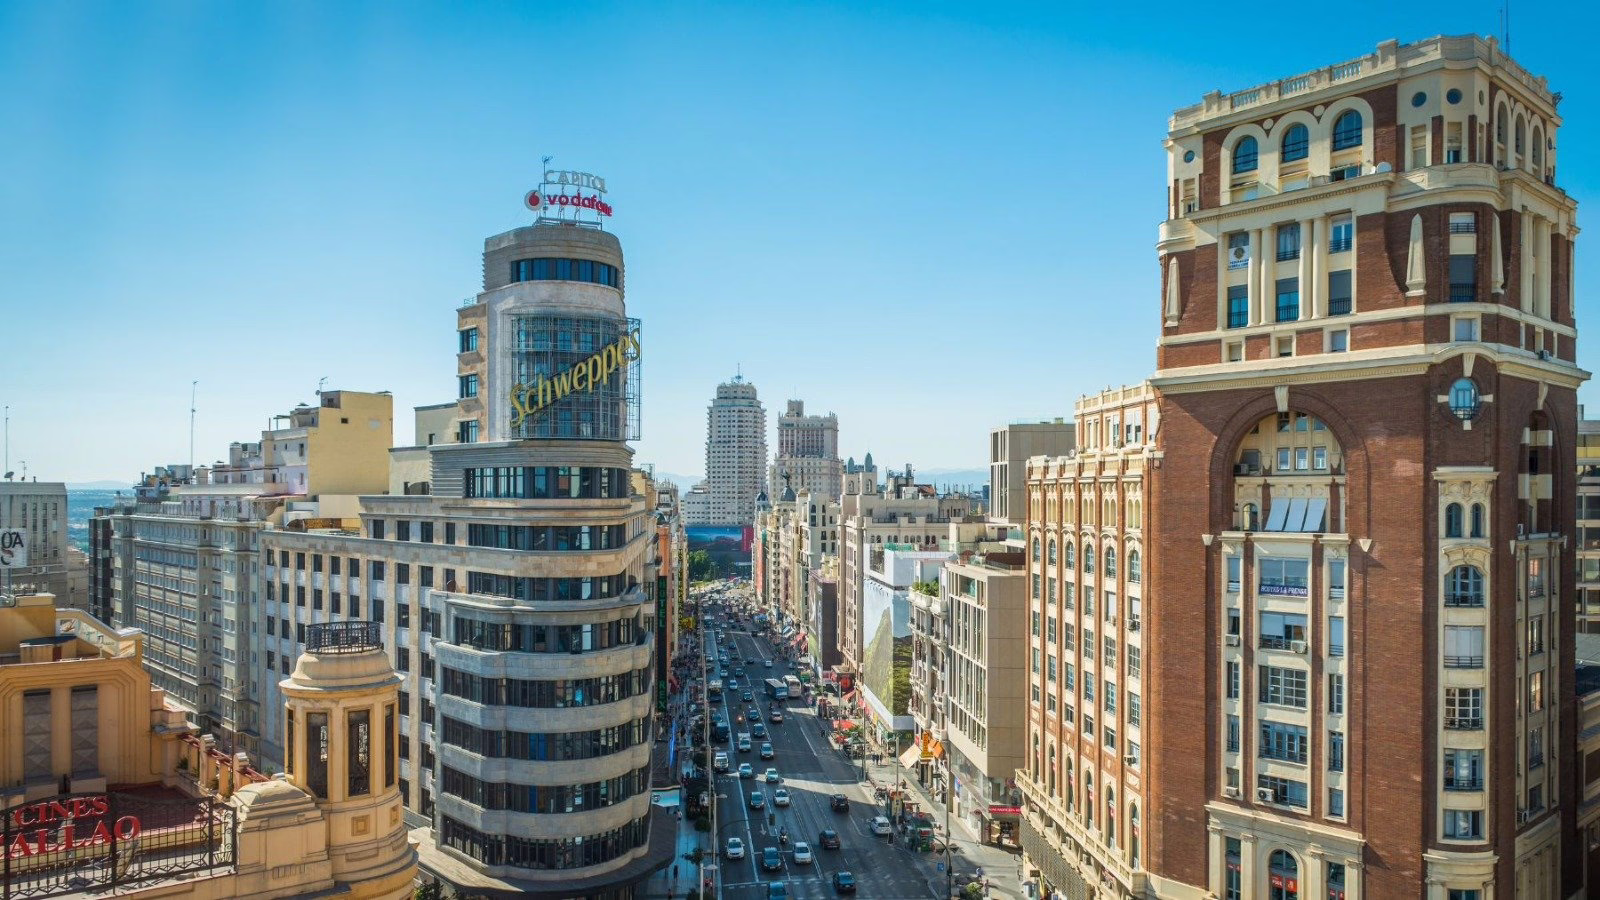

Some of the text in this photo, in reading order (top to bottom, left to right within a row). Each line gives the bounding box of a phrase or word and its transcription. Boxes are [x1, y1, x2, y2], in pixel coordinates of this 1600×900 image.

[545, 169, 607, 193] CAPITOL
[547, 192, 613, 217] vodafone
[509, 327, 641, 428] Schweppes
[15, 794, 111, 825] CINES
